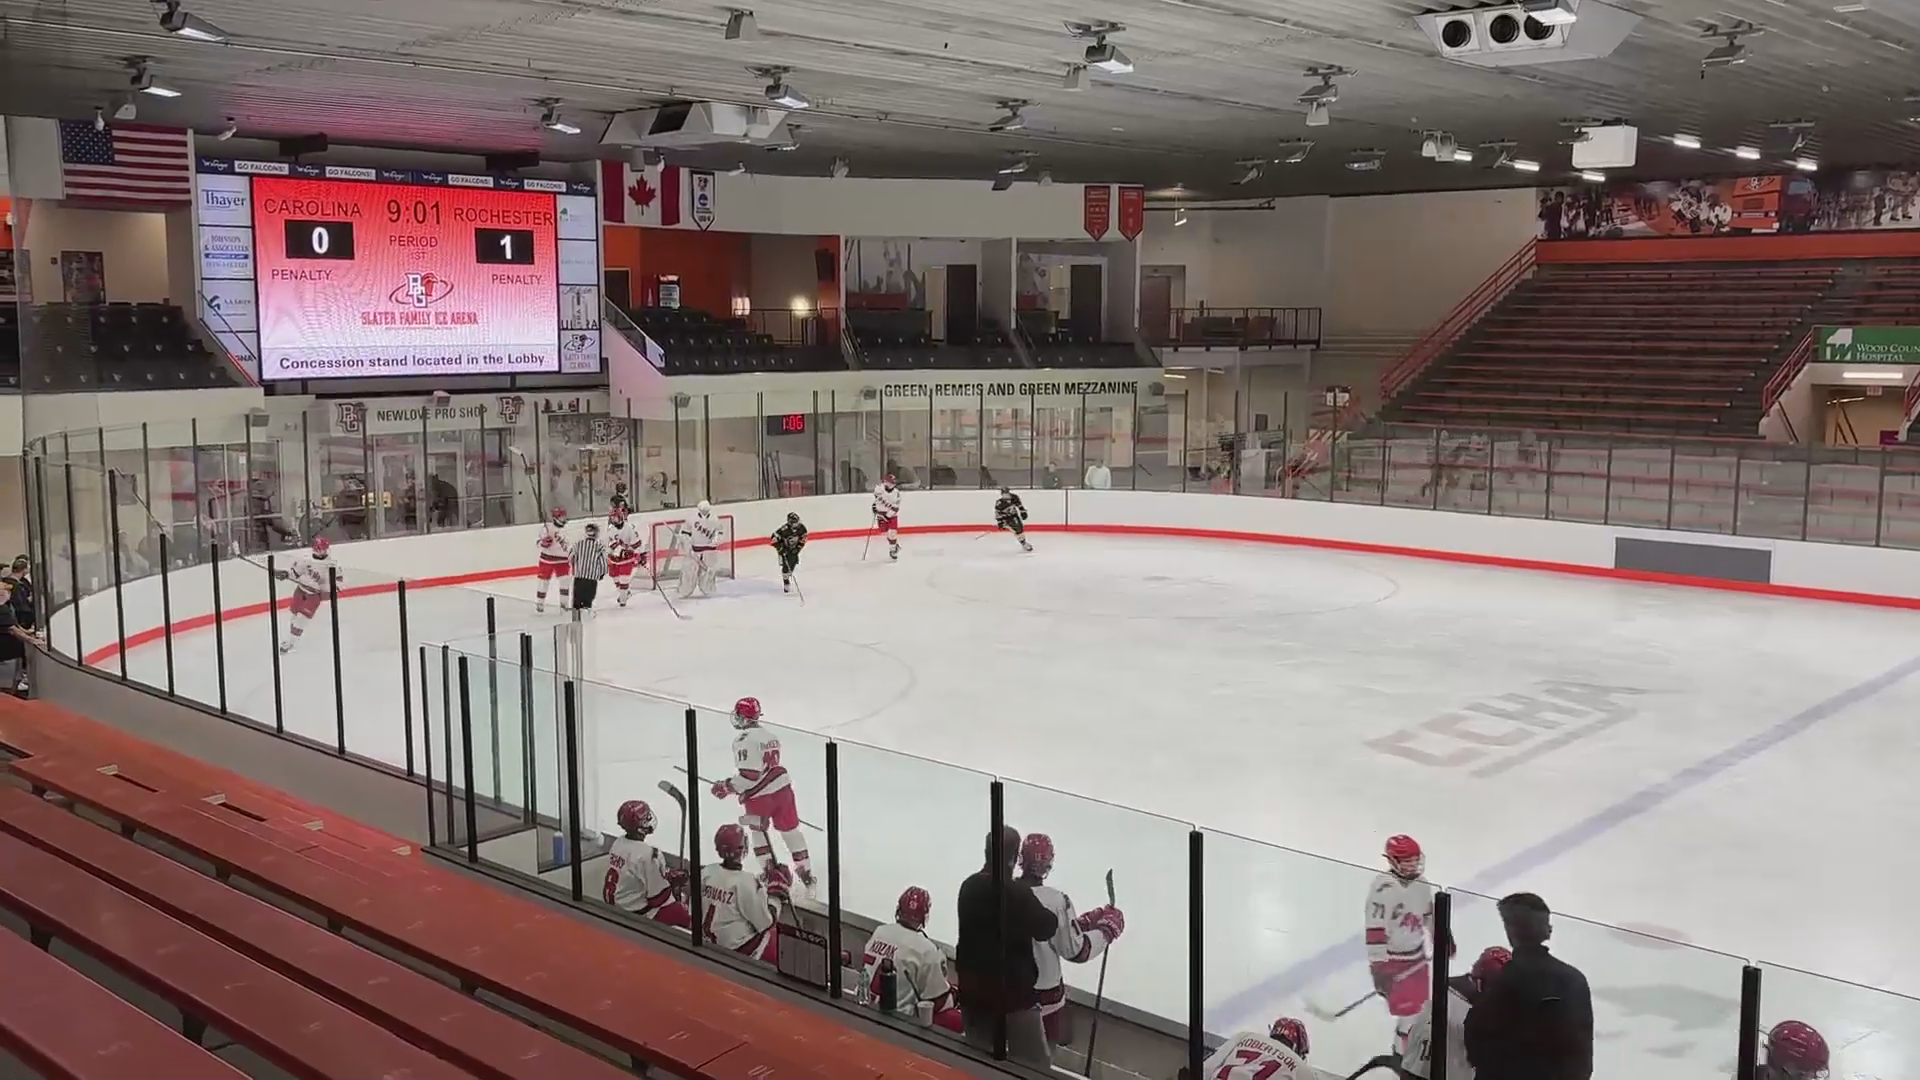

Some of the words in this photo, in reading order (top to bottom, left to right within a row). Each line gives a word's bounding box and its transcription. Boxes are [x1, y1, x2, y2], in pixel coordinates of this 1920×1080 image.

[237, 163, 249, 171] GO
[327, 168, 339, 176] GO
[205, 191, 246, 208] Thayer
[264, 199, 362, 217] CAROLINA
[387, 200, 441, 224] 9:01
[454, 207, 554, 226] ROCHESTER
[311, 226, 329, 254] 0
[389, 235, 438, 248] PERIOD
[500, 234, 513, 260] 1
[271, 268, 333, 281] PENALTY
[491, 273, 543, 285] PENALTY
[361, 311, 396, 325] SLATER
[400, 311, 431, 325] FAMILY
[450, 311, 479, 326] ARENA
[1856, 343, 1888, 352] WOOD
[280, 356, 364, 369] Concession
[368, 355, 408, 367] stand
[413, 354, 462, 366] located
[467, 354, 479, 364] in
[483, 354, 503, 364] the
[508, 353, 545, 366] Lobby
[1857, 352, 1905, 362] HOSPITAL
[935, 383, 984, 396] REMEIS
[987, 382, 1015, 396] AND
[1019, 382, 1060, 395] GREEN
[1064, 381, 1138, 395] MEZZANINE
[435, 407, 456, 419] PRO
[870, 940, 898, 959] KOZAK
[1236, 1038, 1297, 1071] ROBERTSON
